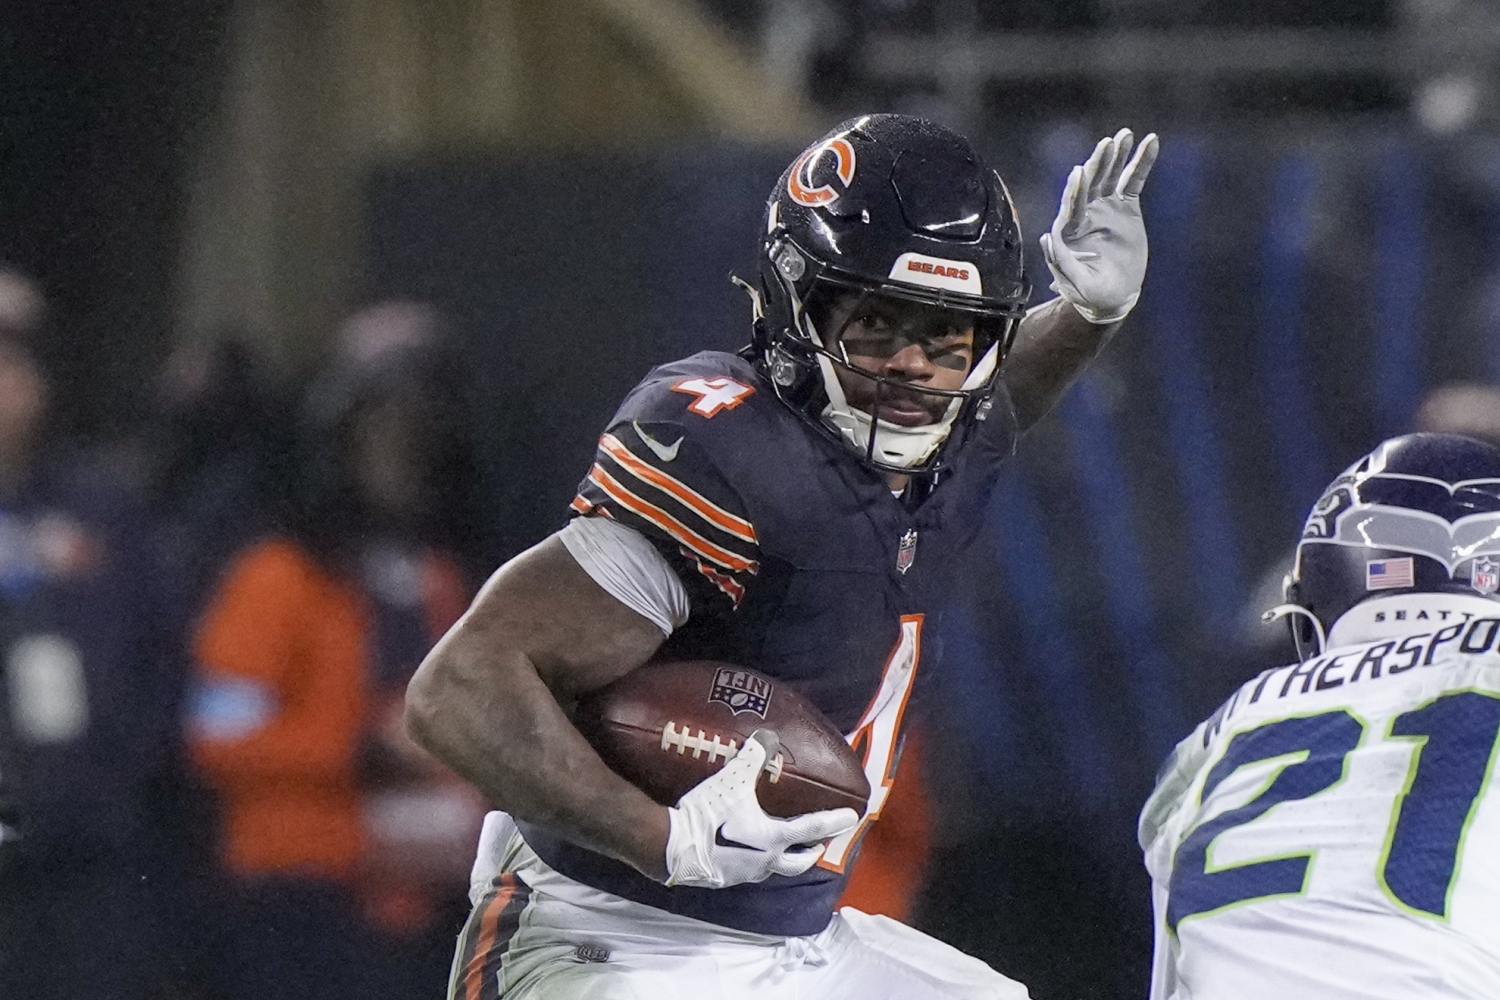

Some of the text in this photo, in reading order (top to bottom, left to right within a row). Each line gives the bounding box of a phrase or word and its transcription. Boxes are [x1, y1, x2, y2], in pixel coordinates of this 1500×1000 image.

[788, 139, 856, 208] C
[907, 261, 970, 280] BEARS
[670, 375, 757, 419] 4
[718, 670, 770, 699] NFL
